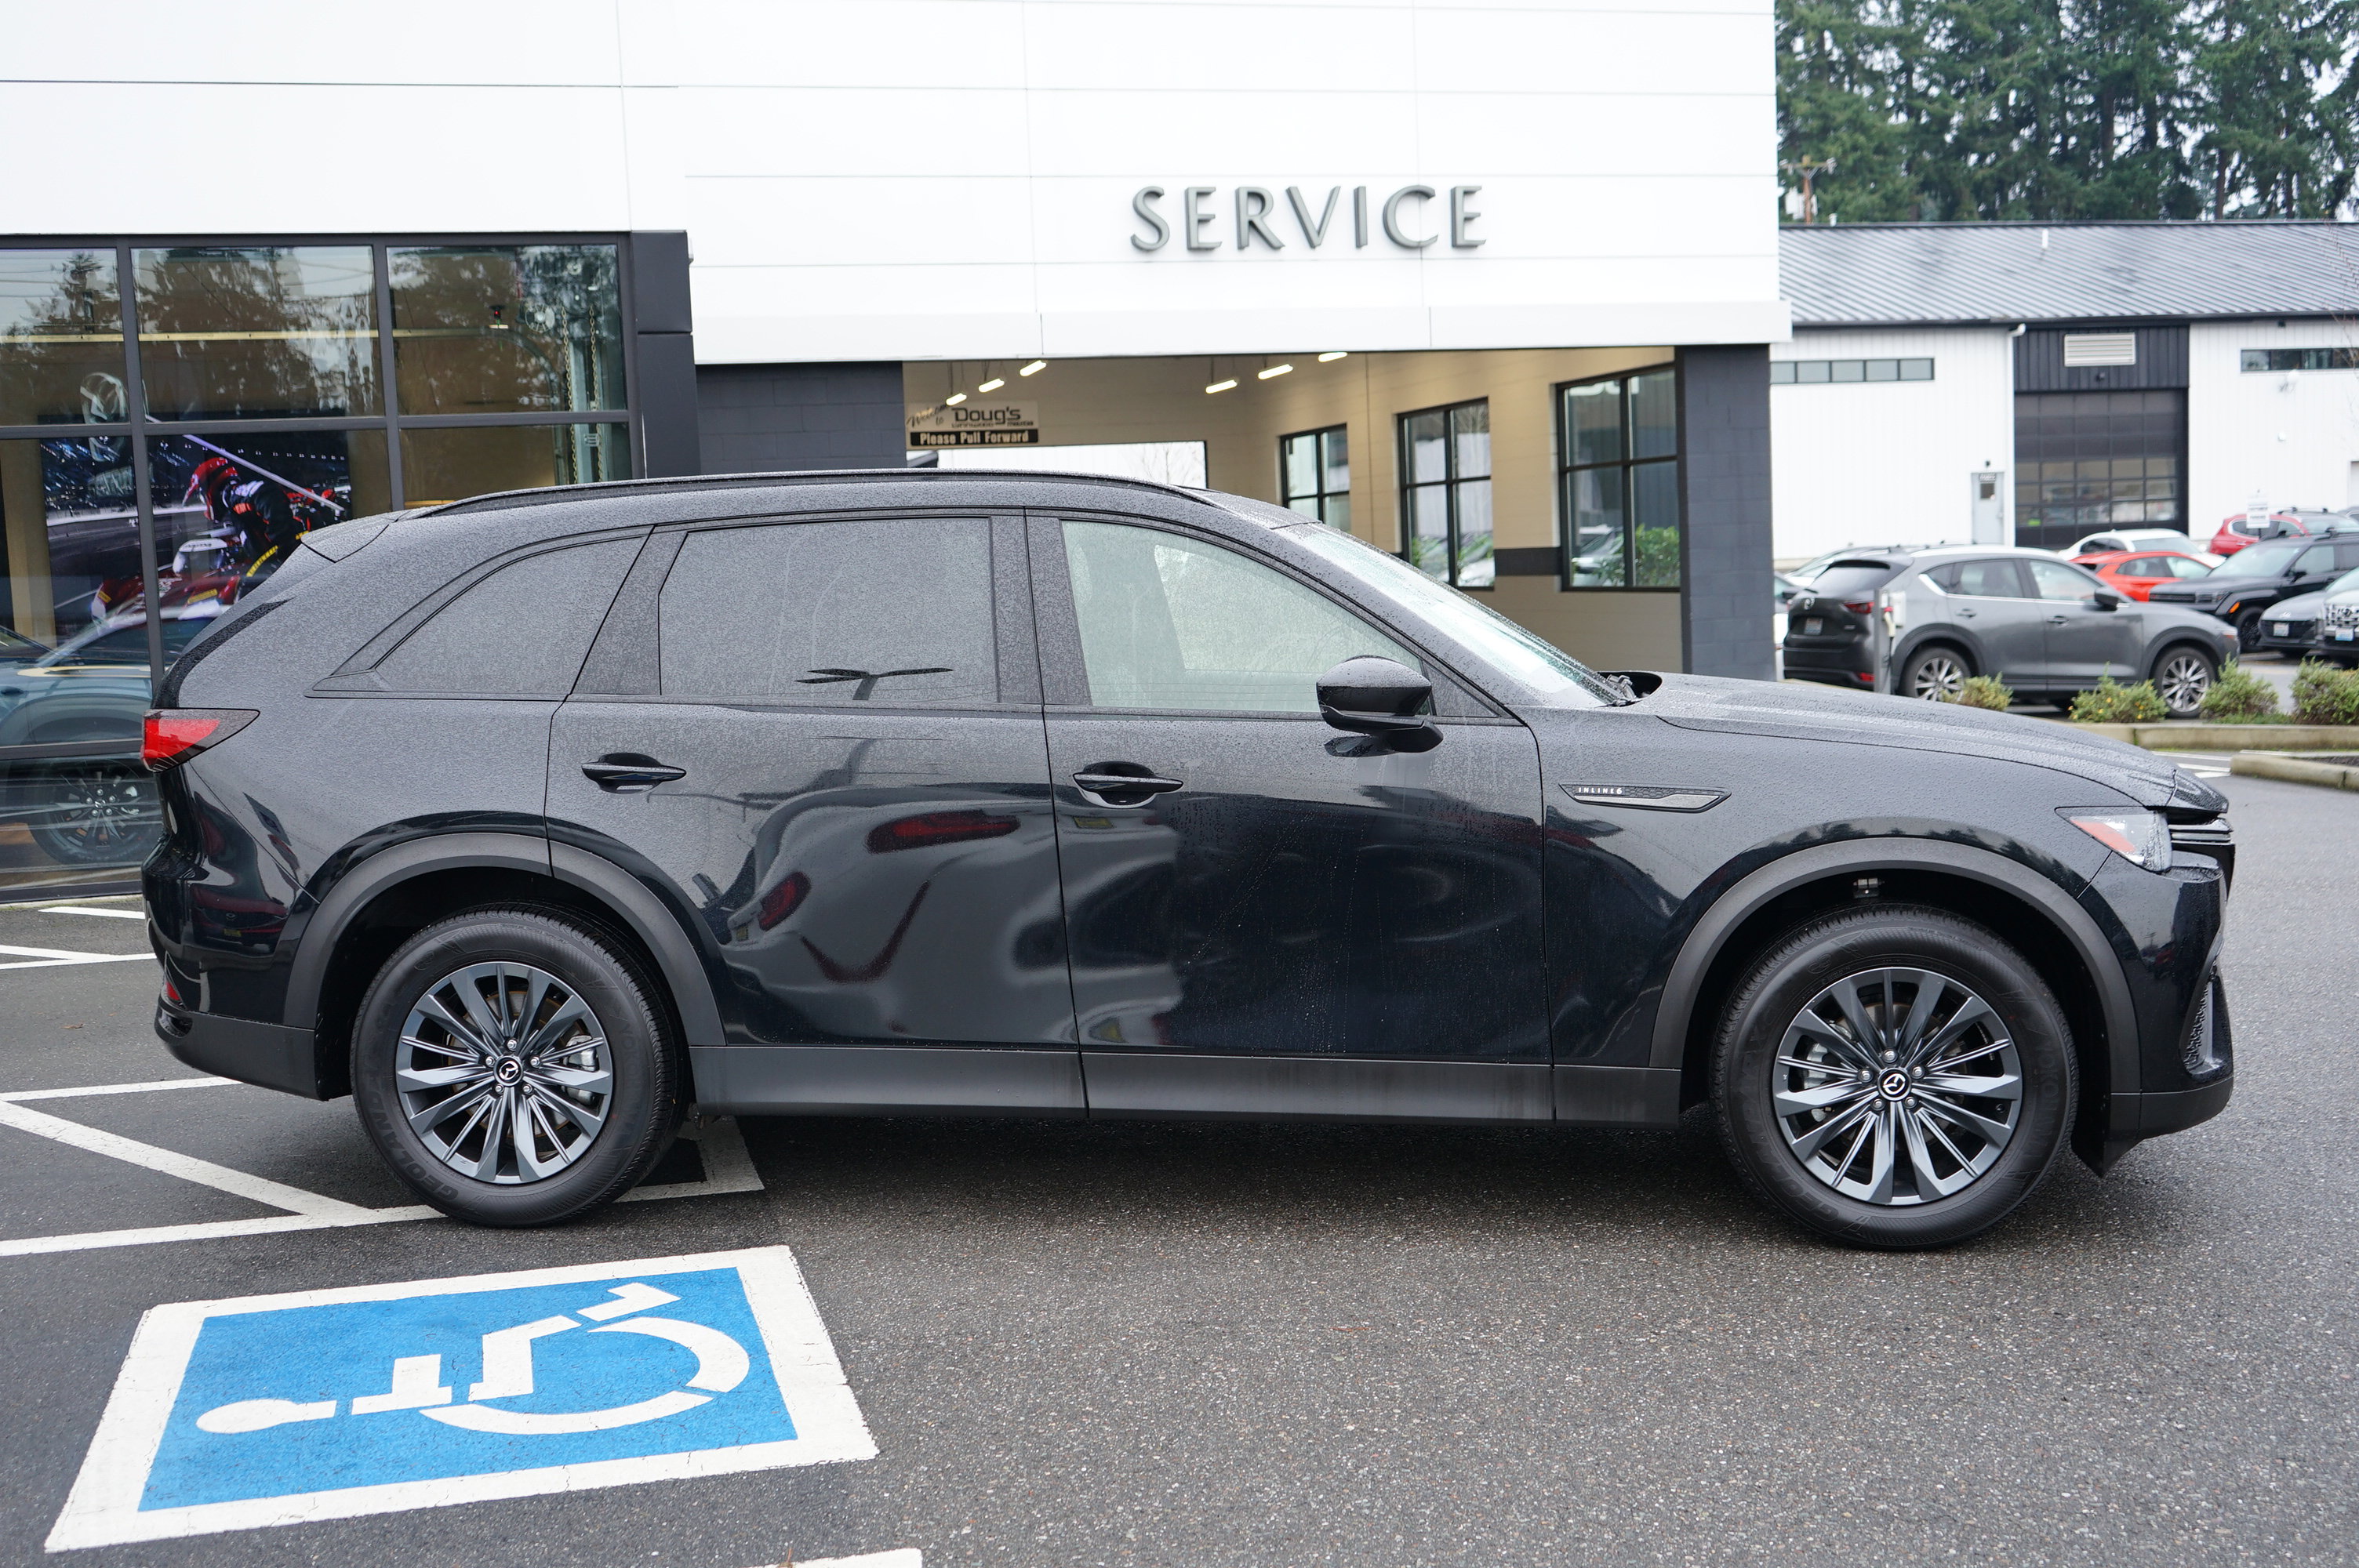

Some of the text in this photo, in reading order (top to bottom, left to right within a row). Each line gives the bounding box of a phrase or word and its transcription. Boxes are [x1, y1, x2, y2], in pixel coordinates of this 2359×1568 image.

[1130, 184, 1487, 252] SERVICE
[951, 406, 1021, 425] Doug's
[920, 431, 1029, 445] Please Pull Forward
